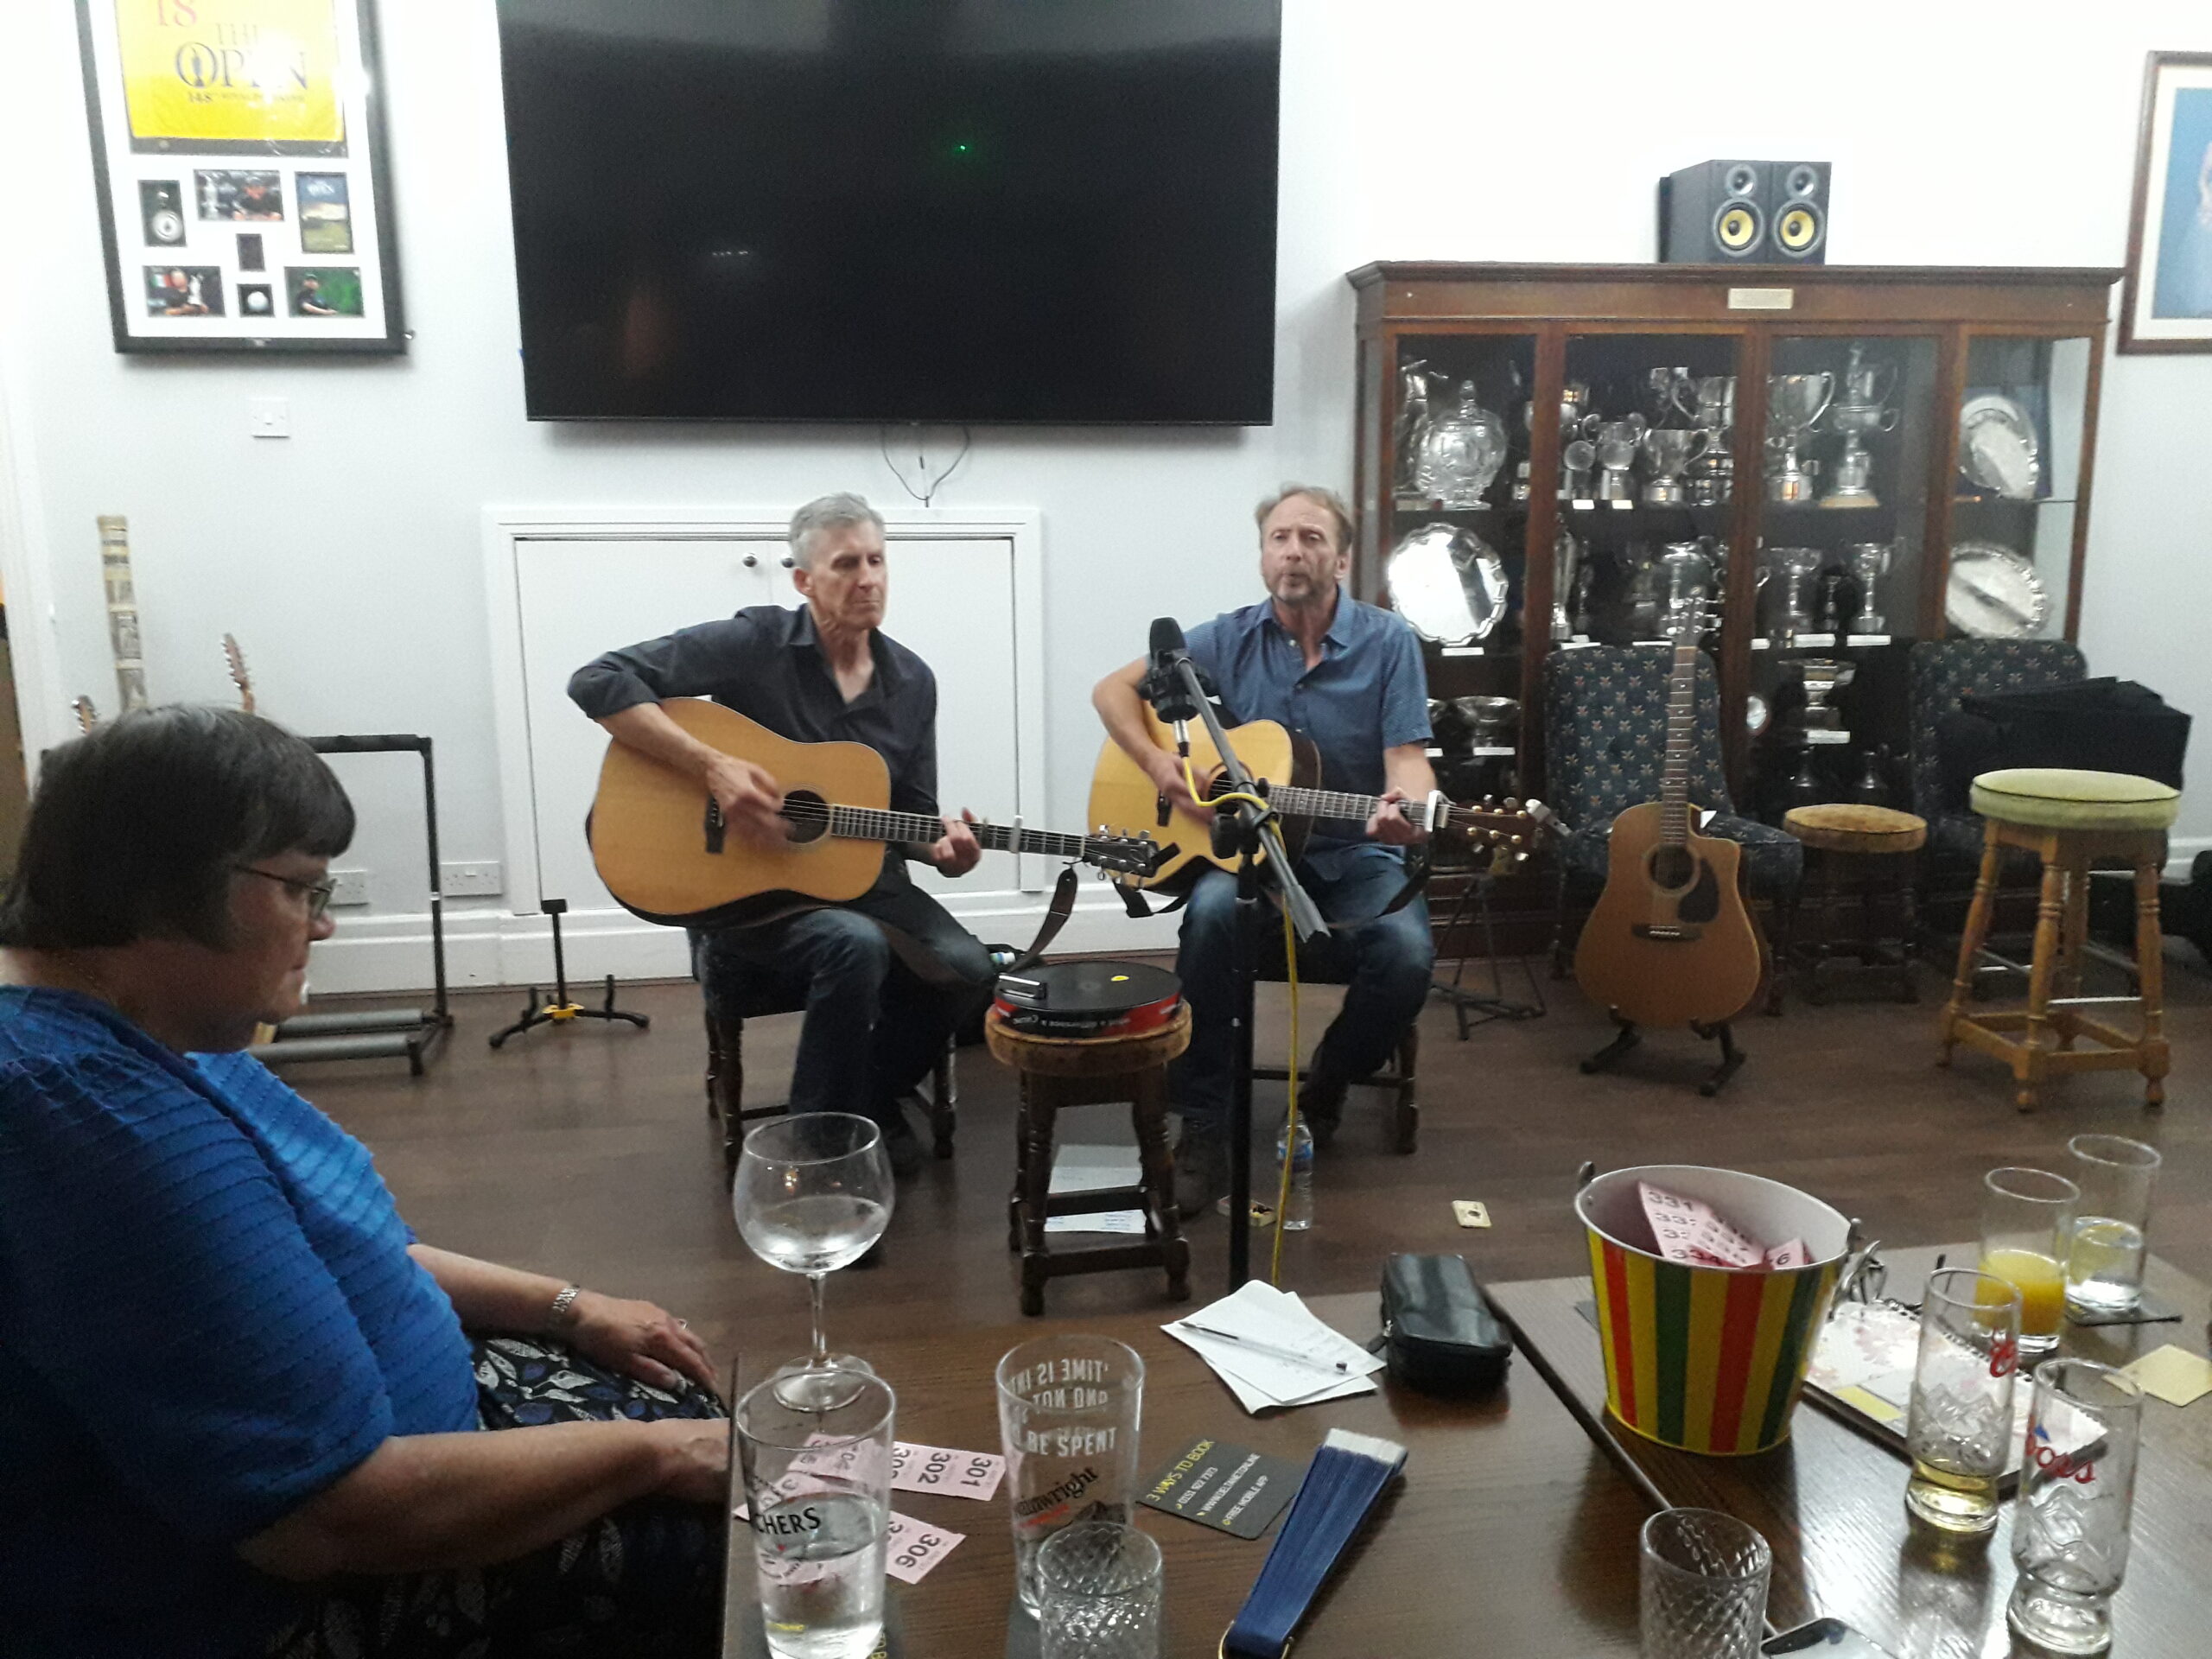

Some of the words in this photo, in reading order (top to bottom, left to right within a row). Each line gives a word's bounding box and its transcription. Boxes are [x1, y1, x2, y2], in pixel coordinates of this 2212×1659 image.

[175, 41, 308, 90] OPN
[1027, 1430, 1049, 1456] BE
[1057, 1427, 1116, 1458] SPENT
[917, 1452, 951, 1484] 302
[960, 1456, 993, 1488] 301
[1153, 1471, 1183, 1495] WAYS
[1173, 1459, 1194, 1471] TO
[1185, 1439, 1216, 1462] BOOK
[1224, 1503, 1244, 1521] FREE
[894, 1533, 942, 1568] 306
